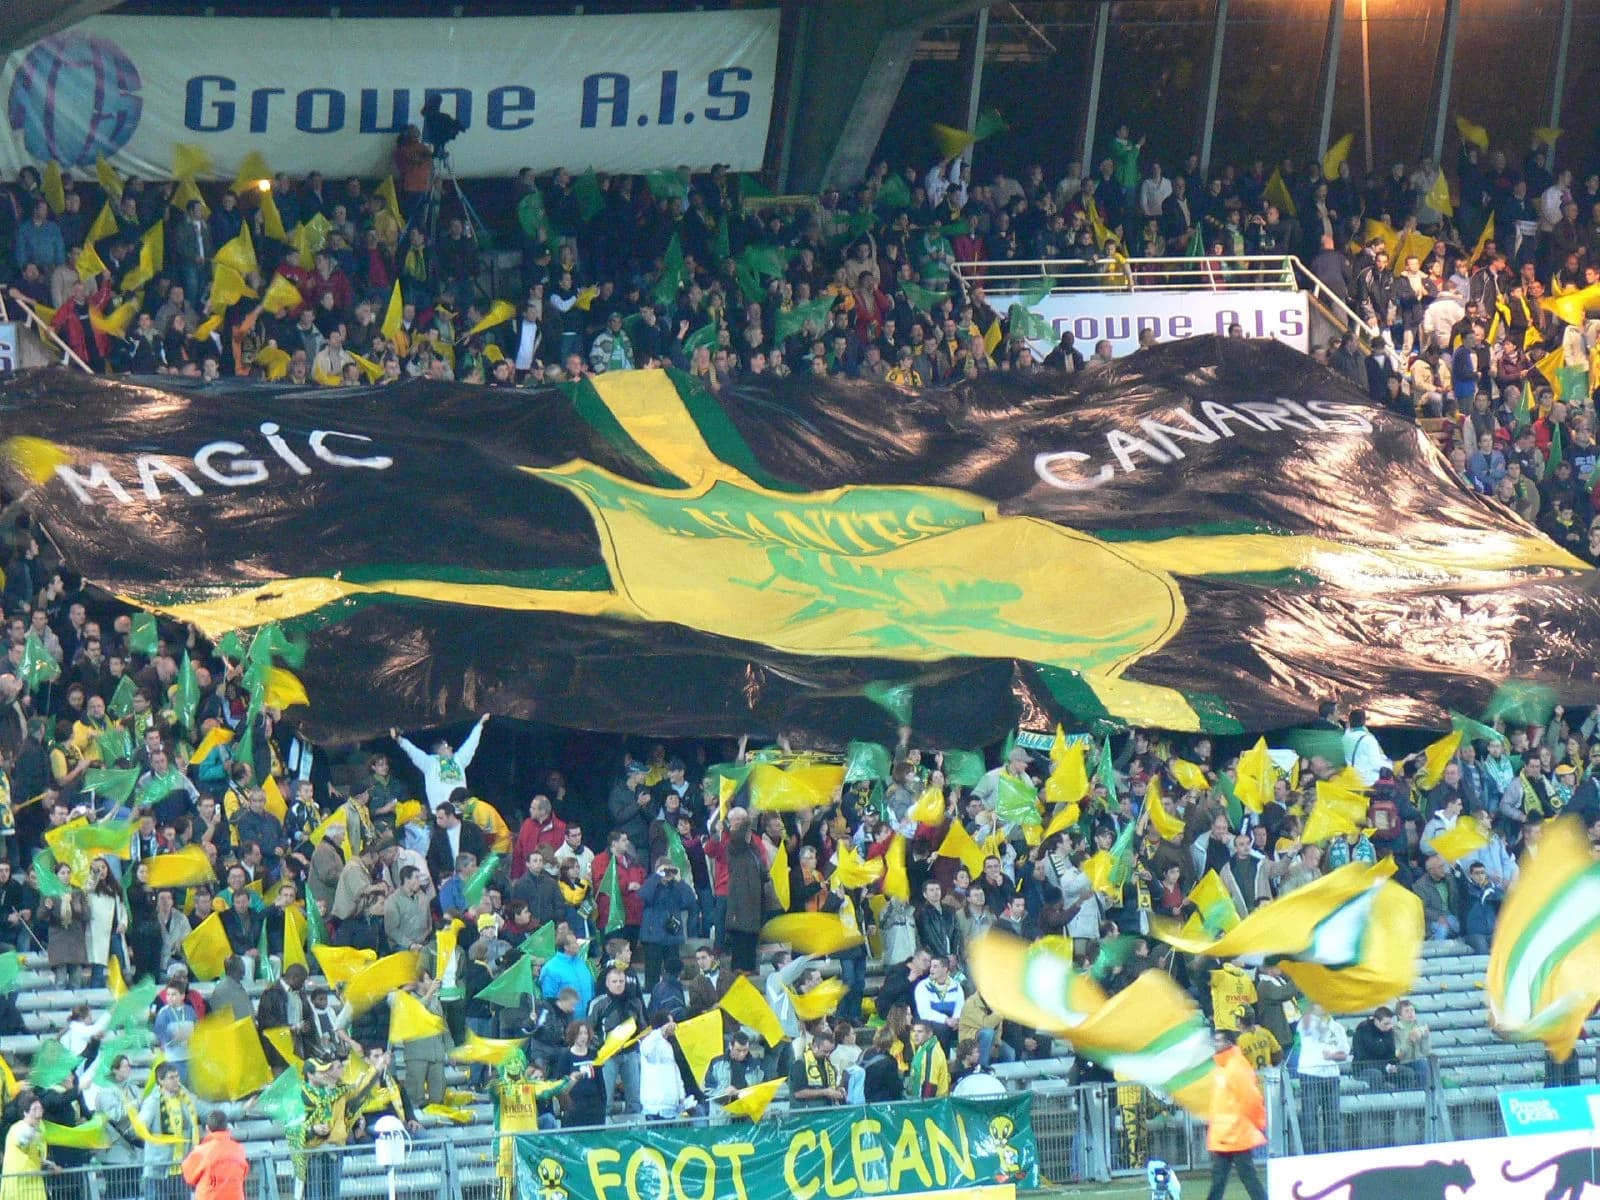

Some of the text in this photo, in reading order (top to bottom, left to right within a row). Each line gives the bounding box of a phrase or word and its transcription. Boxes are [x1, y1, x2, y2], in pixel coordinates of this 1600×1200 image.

[185, 66, 753, 142] Groupe A.I.S
[1034, 397, 1374, 490] CANARIS
[682, 504, 952, 555] NANTES
[587, 1113, 977, 1200] FOOT CLEAN
